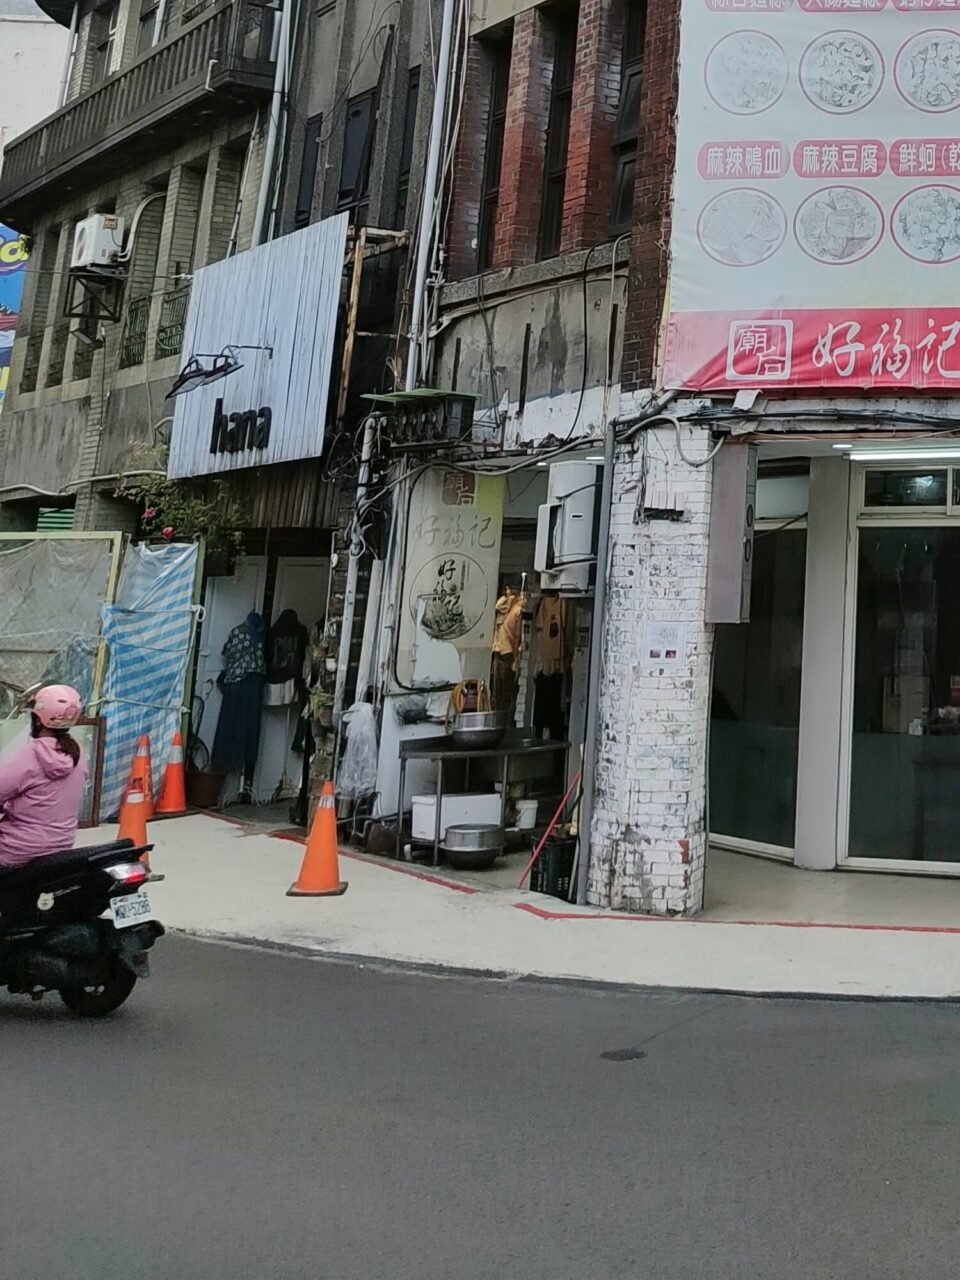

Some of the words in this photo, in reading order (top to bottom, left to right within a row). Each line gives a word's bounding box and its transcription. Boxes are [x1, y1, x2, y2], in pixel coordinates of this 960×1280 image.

[801, 144, 878, 175] 麻辣豆腐
[210, 398, 272, 454] hana
